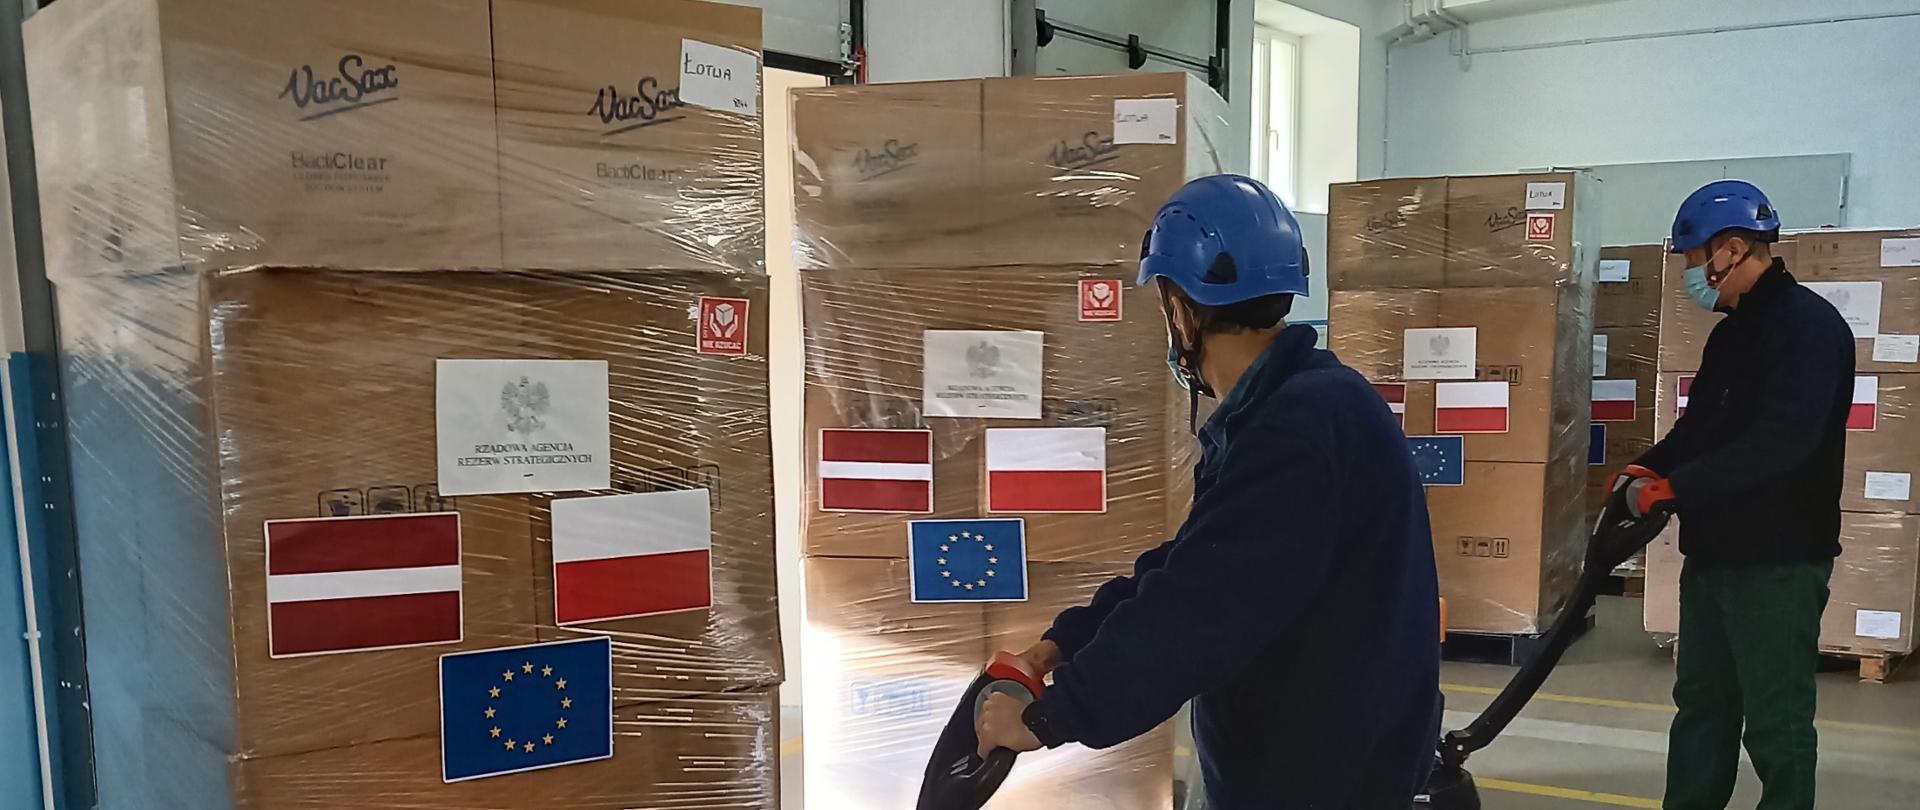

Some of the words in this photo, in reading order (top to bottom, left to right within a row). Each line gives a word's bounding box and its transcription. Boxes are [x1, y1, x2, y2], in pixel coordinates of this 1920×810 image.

[684, 52, 732, 81] ŁOTWA
[278, 54, 398, 109] VacSax
[475, 444, 528, 455] RZĄDOWA
[531, 442, 574, 453] AGENCJA
[457, 456, 500, 467] REZERW
[503, 454, 593, 465] STRATEGICZNYCH
